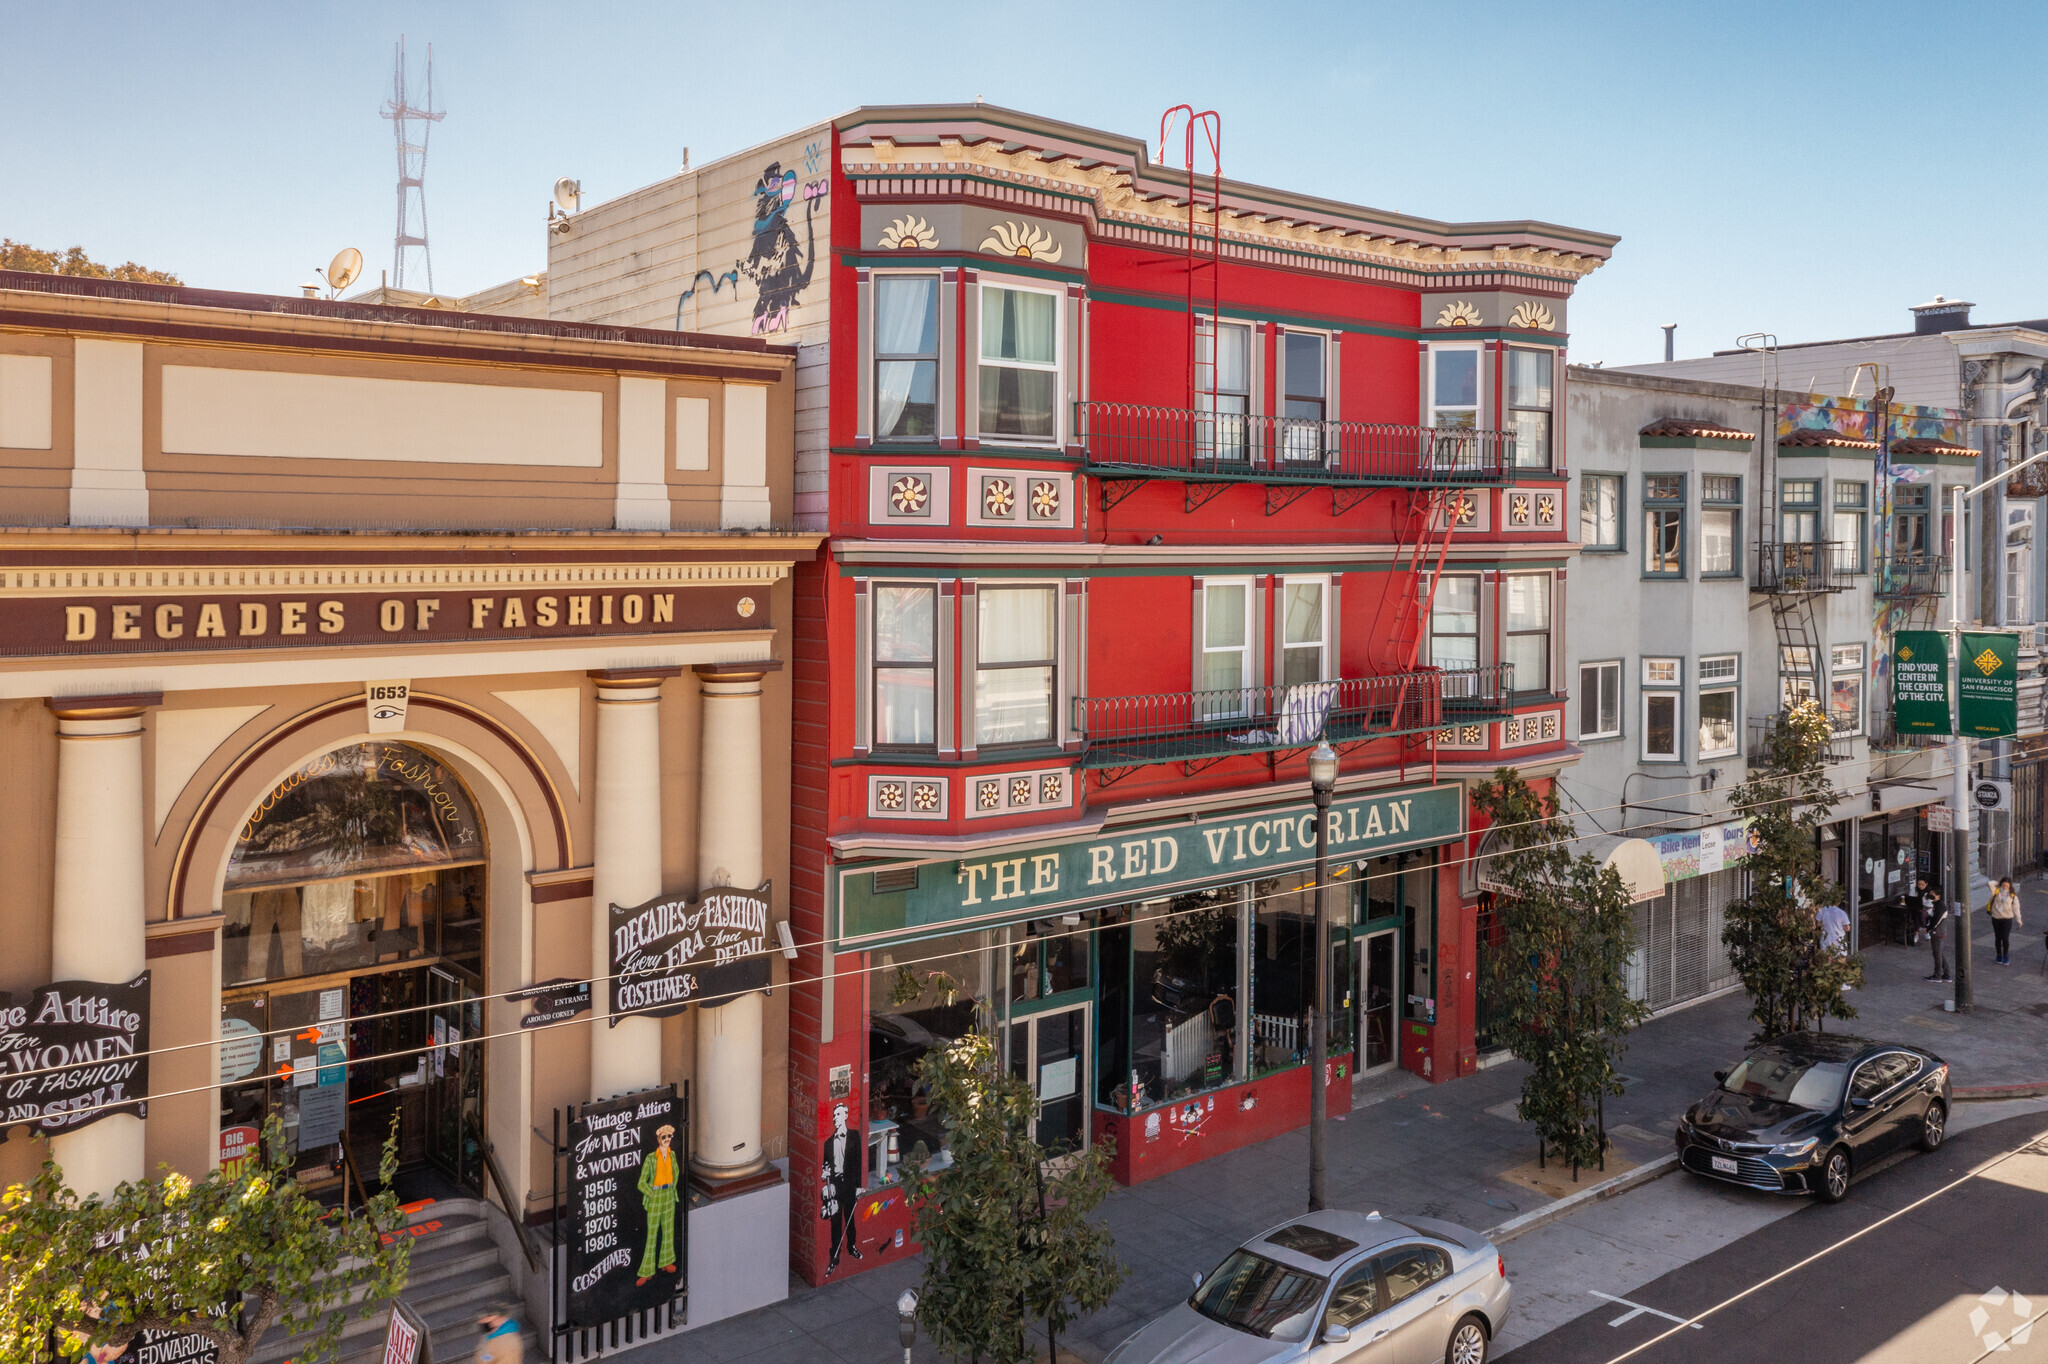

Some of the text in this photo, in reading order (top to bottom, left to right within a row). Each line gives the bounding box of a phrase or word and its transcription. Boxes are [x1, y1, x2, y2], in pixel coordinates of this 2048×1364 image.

[65, 593, 675, 641] DECADES OF FASHION
[1897, 662, 1938, 672] FIND YOUR
[1897, 672, 1937, 682] CENTER IN
[369, 685, 407, 700] 1653
[1897, 682, 1944, 692] THE CENTER
[1961, 677, 2002, 685] UNIVERSITY
[1976, 684, 2013, 693] FRANCISCO
[1898, 692, 1945, 702] OF THE CITY.
[377, 746, 460, 821] Fashion
[1660, 838, 1680, 855] Bike
[1701, 831, 1710, 840] For
[1701, 840, 1716, 850] Lease
[956, 799, 1412, 906] THE RED VICTORIAN
[614, 894, 768, 963] DECADES of FASHION
[618, 929, 742, 985] Every ERA And
[714, 936, 767, 967] DETAIL
[554, 993, 589, 1006] ENTRANCE
[618, 973, 699, 1011] COSTUMES &
[34, 991, 141, 1032] Attire
[526, 1009, 575, 1024] AROUND CORNER
[0, 1032, 41, 1050] For
[10, 1033, 137, 1074] WOMEN
[7, 1061, 139, 1099] OF FASHION
[7, 1082, 131, 1128] AND SELL
[586, 1099, 672, 1132] Vintage Attire
[225, 1131, 244, 1147] BIG
[575, 1126, 642, 1165] For MEN
[576, 1149, 642, 1181] & WOMEN
[584, 1177, 618, 1200] 1950's
[583, 1195, 618, 1218] 1960's
[584, 1214, 618, 1237] 1970's
[585, 1232, 618, 1254] 1980's
[572, 1248, 632, 1293] COSTUMES
